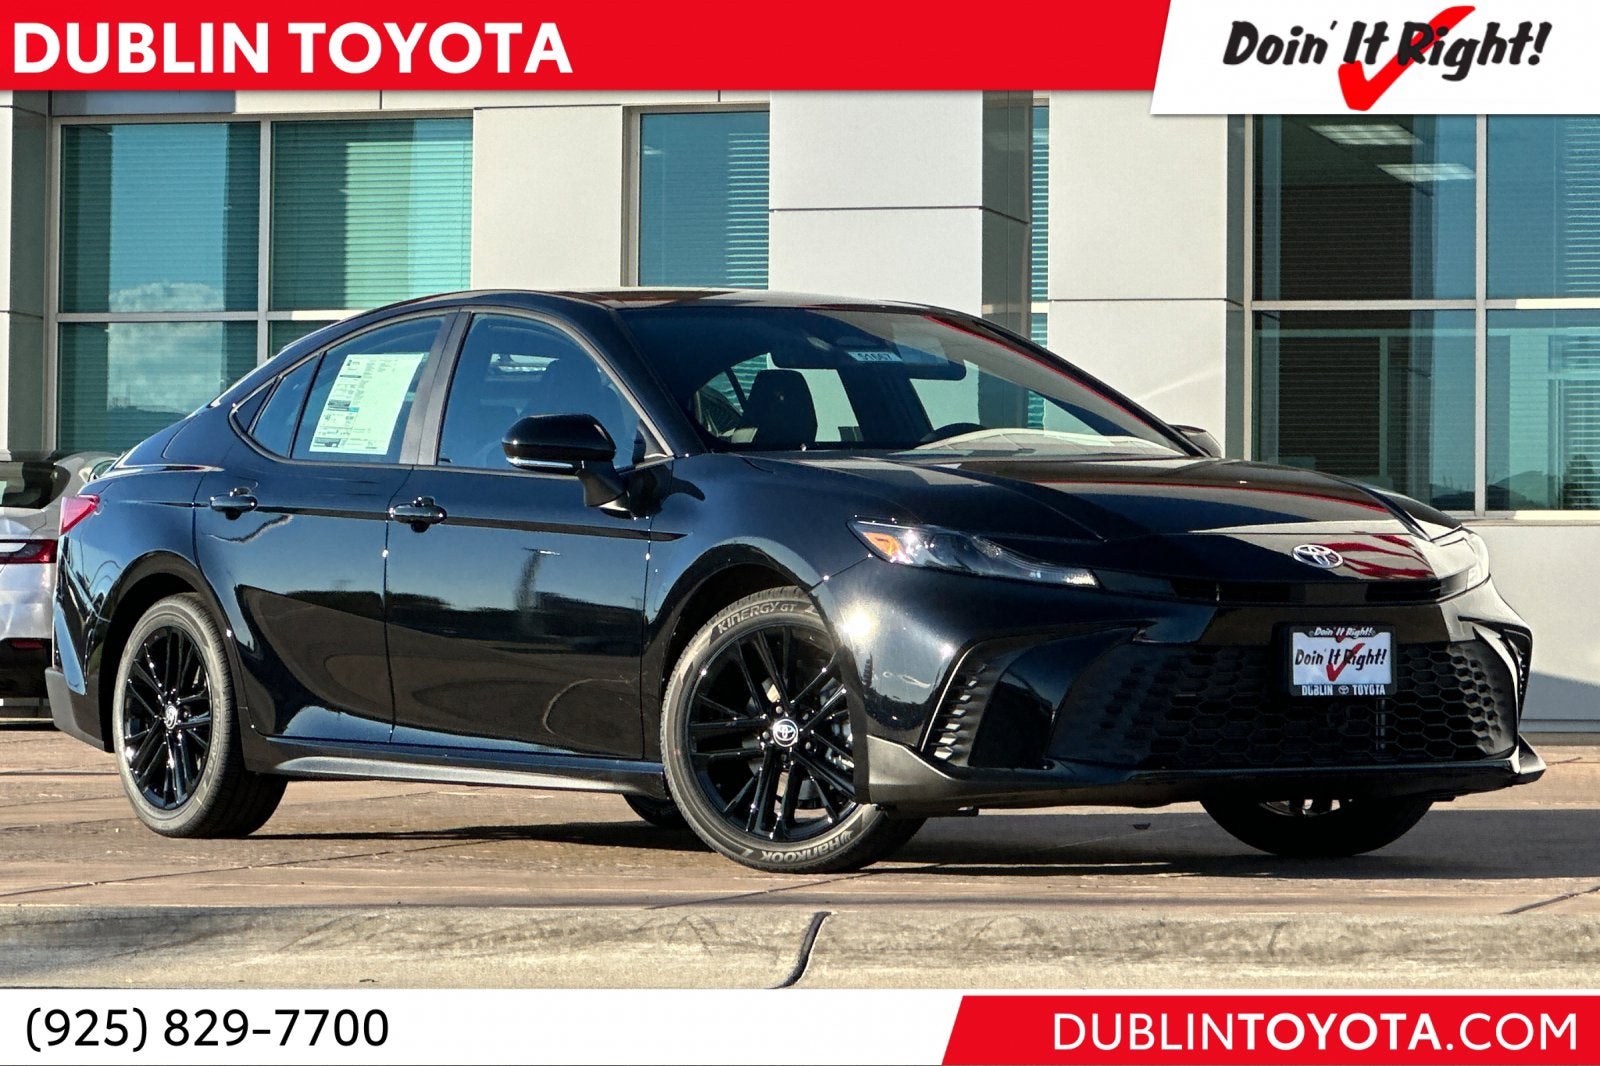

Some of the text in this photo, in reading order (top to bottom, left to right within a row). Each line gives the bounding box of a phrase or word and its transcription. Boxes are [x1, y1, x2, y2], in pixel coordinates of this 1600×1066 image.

[780, 604, 797, 612] GT
[1328, 649, 1341, 665] It
[1343, 649, 1388, 671] Right!
[1301, 685, 1386, 696] DUBLIN TOYOTA
